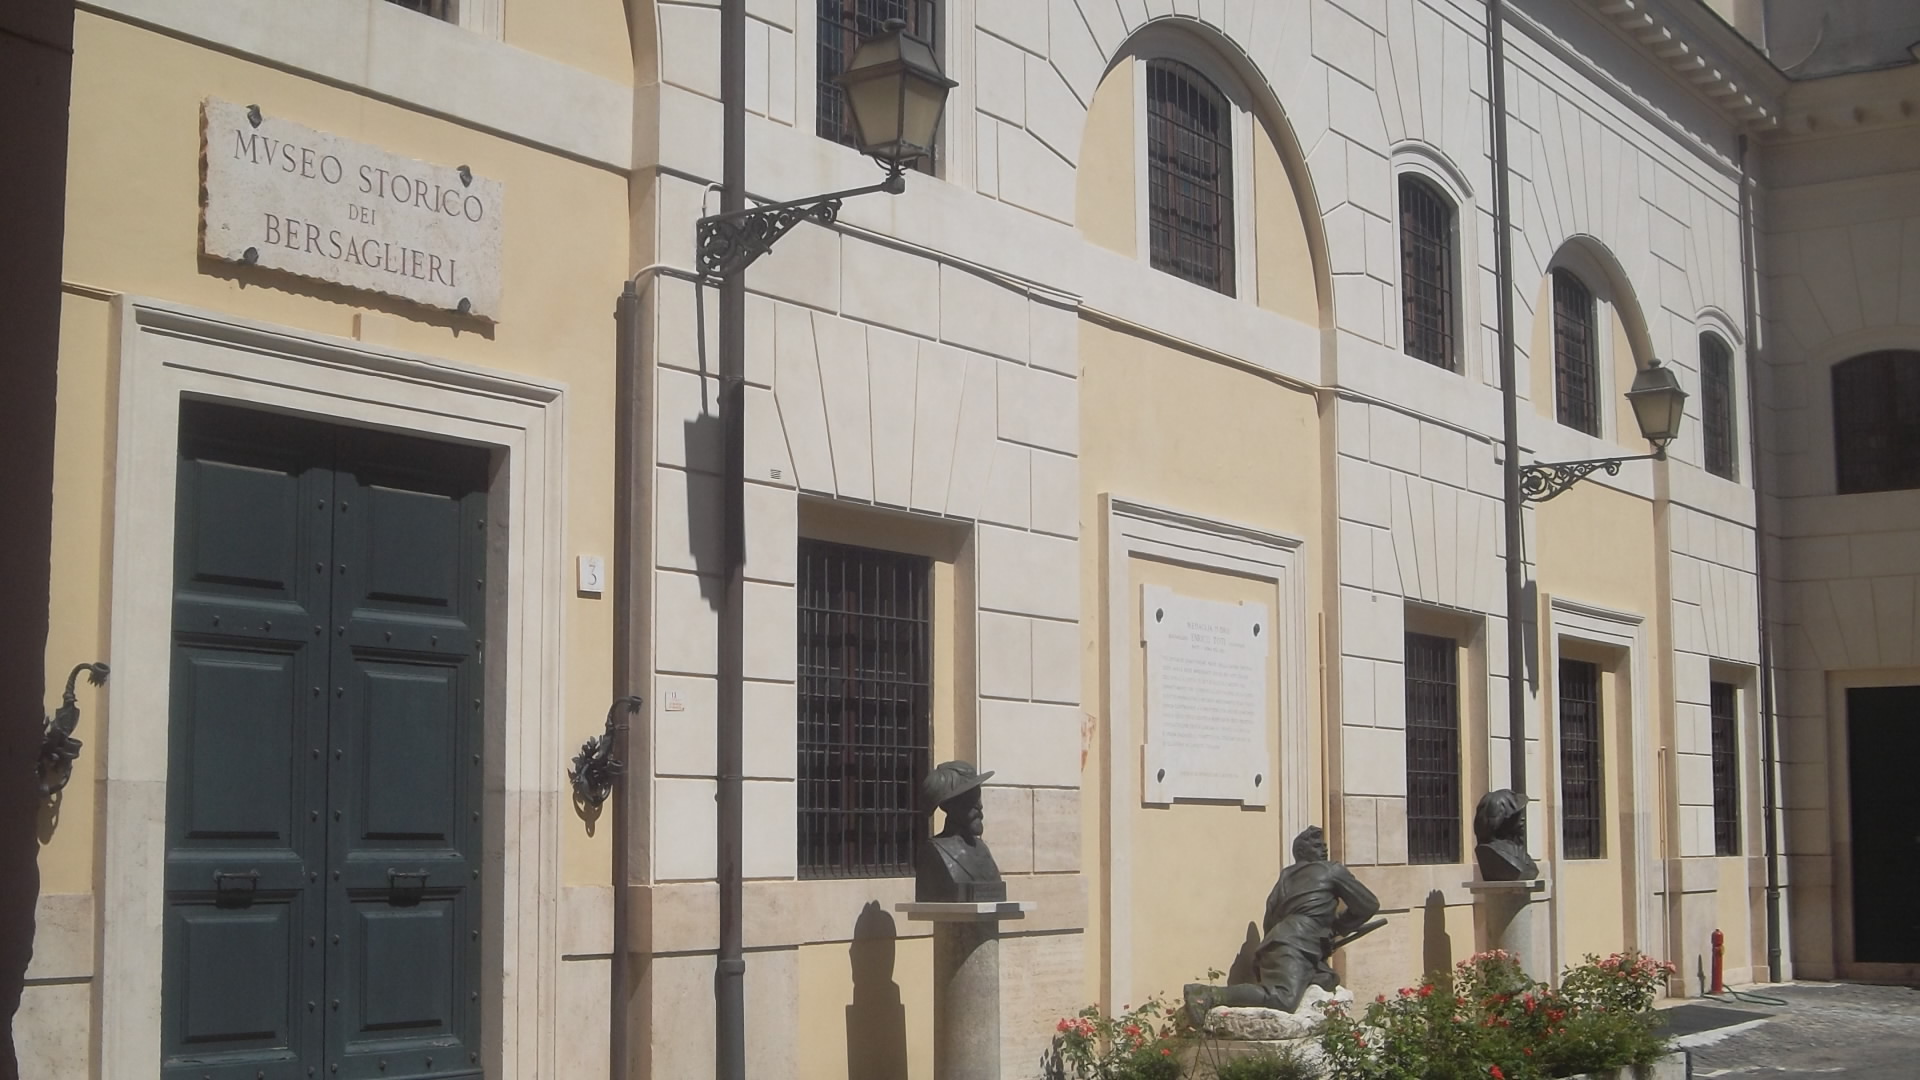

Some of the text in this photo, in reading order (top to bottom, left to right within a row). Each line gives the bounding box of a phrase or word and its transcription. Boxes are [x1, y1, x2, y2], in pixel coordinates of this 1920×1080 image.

[233, 129, 484, 222] MVSEO STORICO
[347, 203, 376, 226] DEI
[263, 212, 456, 288] BERSAGLIERI
[588, 564, 597, 586] 3
